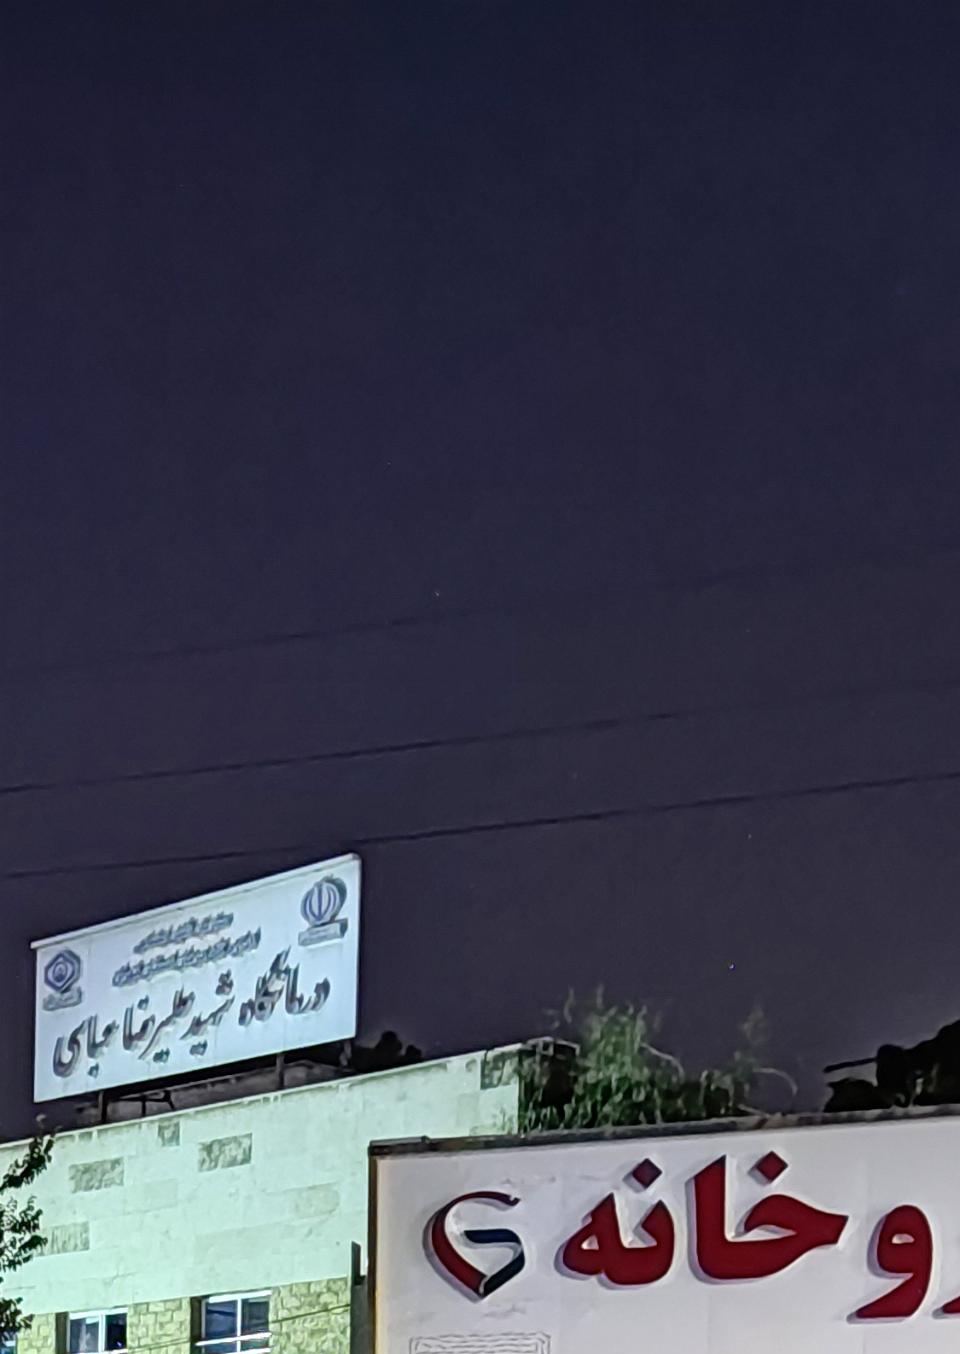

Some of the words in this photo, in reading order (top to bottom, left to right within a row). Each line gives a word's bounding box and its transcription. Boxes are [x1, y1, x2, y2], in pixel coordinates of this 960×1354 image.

[180, 969, 235, 1056] شهید
[238, 947, 331, 1026] درمانگاه
[557, 1151, 960, 1321] وخانه
